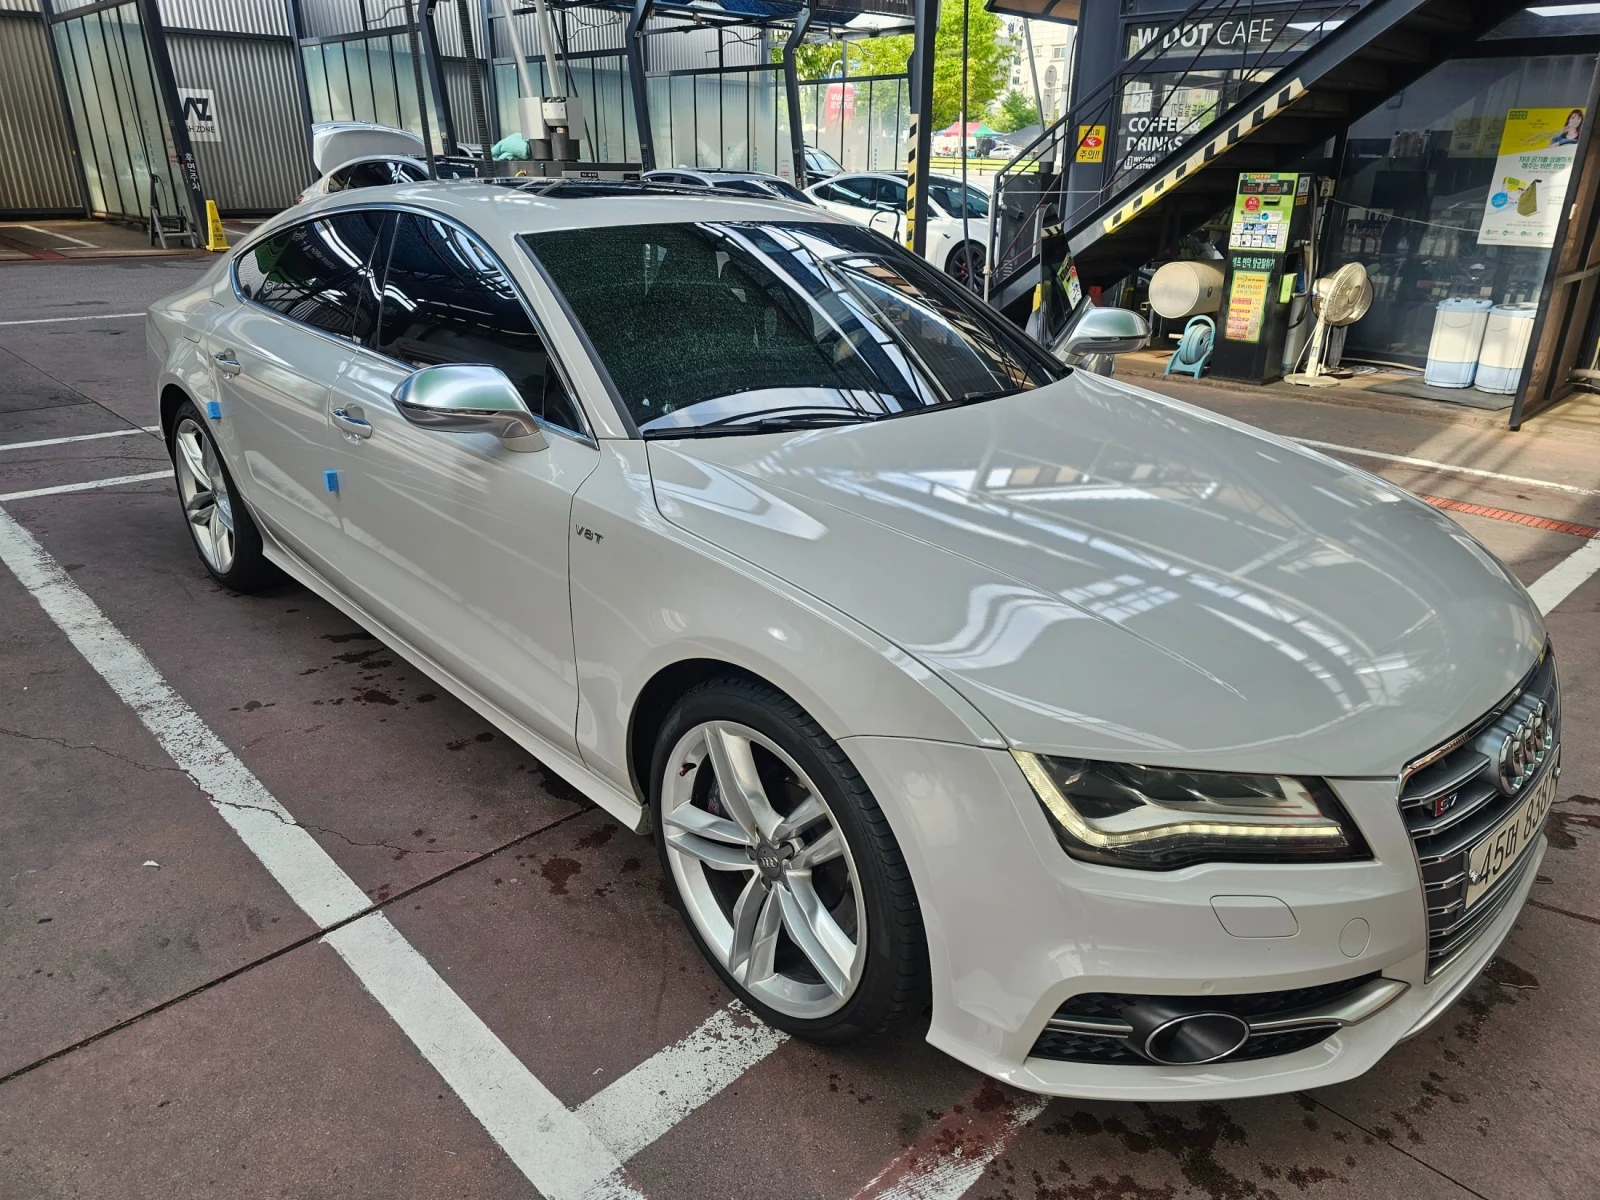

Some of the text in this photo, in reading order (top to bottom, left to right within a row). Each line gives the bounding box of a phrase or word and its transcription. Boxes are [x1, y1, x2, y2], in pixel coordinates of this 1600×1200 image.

[1162, 23, 1213, 48] DOT
[1217, 19, 1275, 45] CAFE
[196, 125, 215, 133] ZONE
[1128, 117, 1185, 132] COFFEE
[1126, 136, 1183, 151] DRINKS
[1080, 150, 1100, 159] 주의!!
[185, 152, 200, 191] 후면주차
[575, 523, 604, 545] V8T
[1440, 792, 1458, 812] S7
